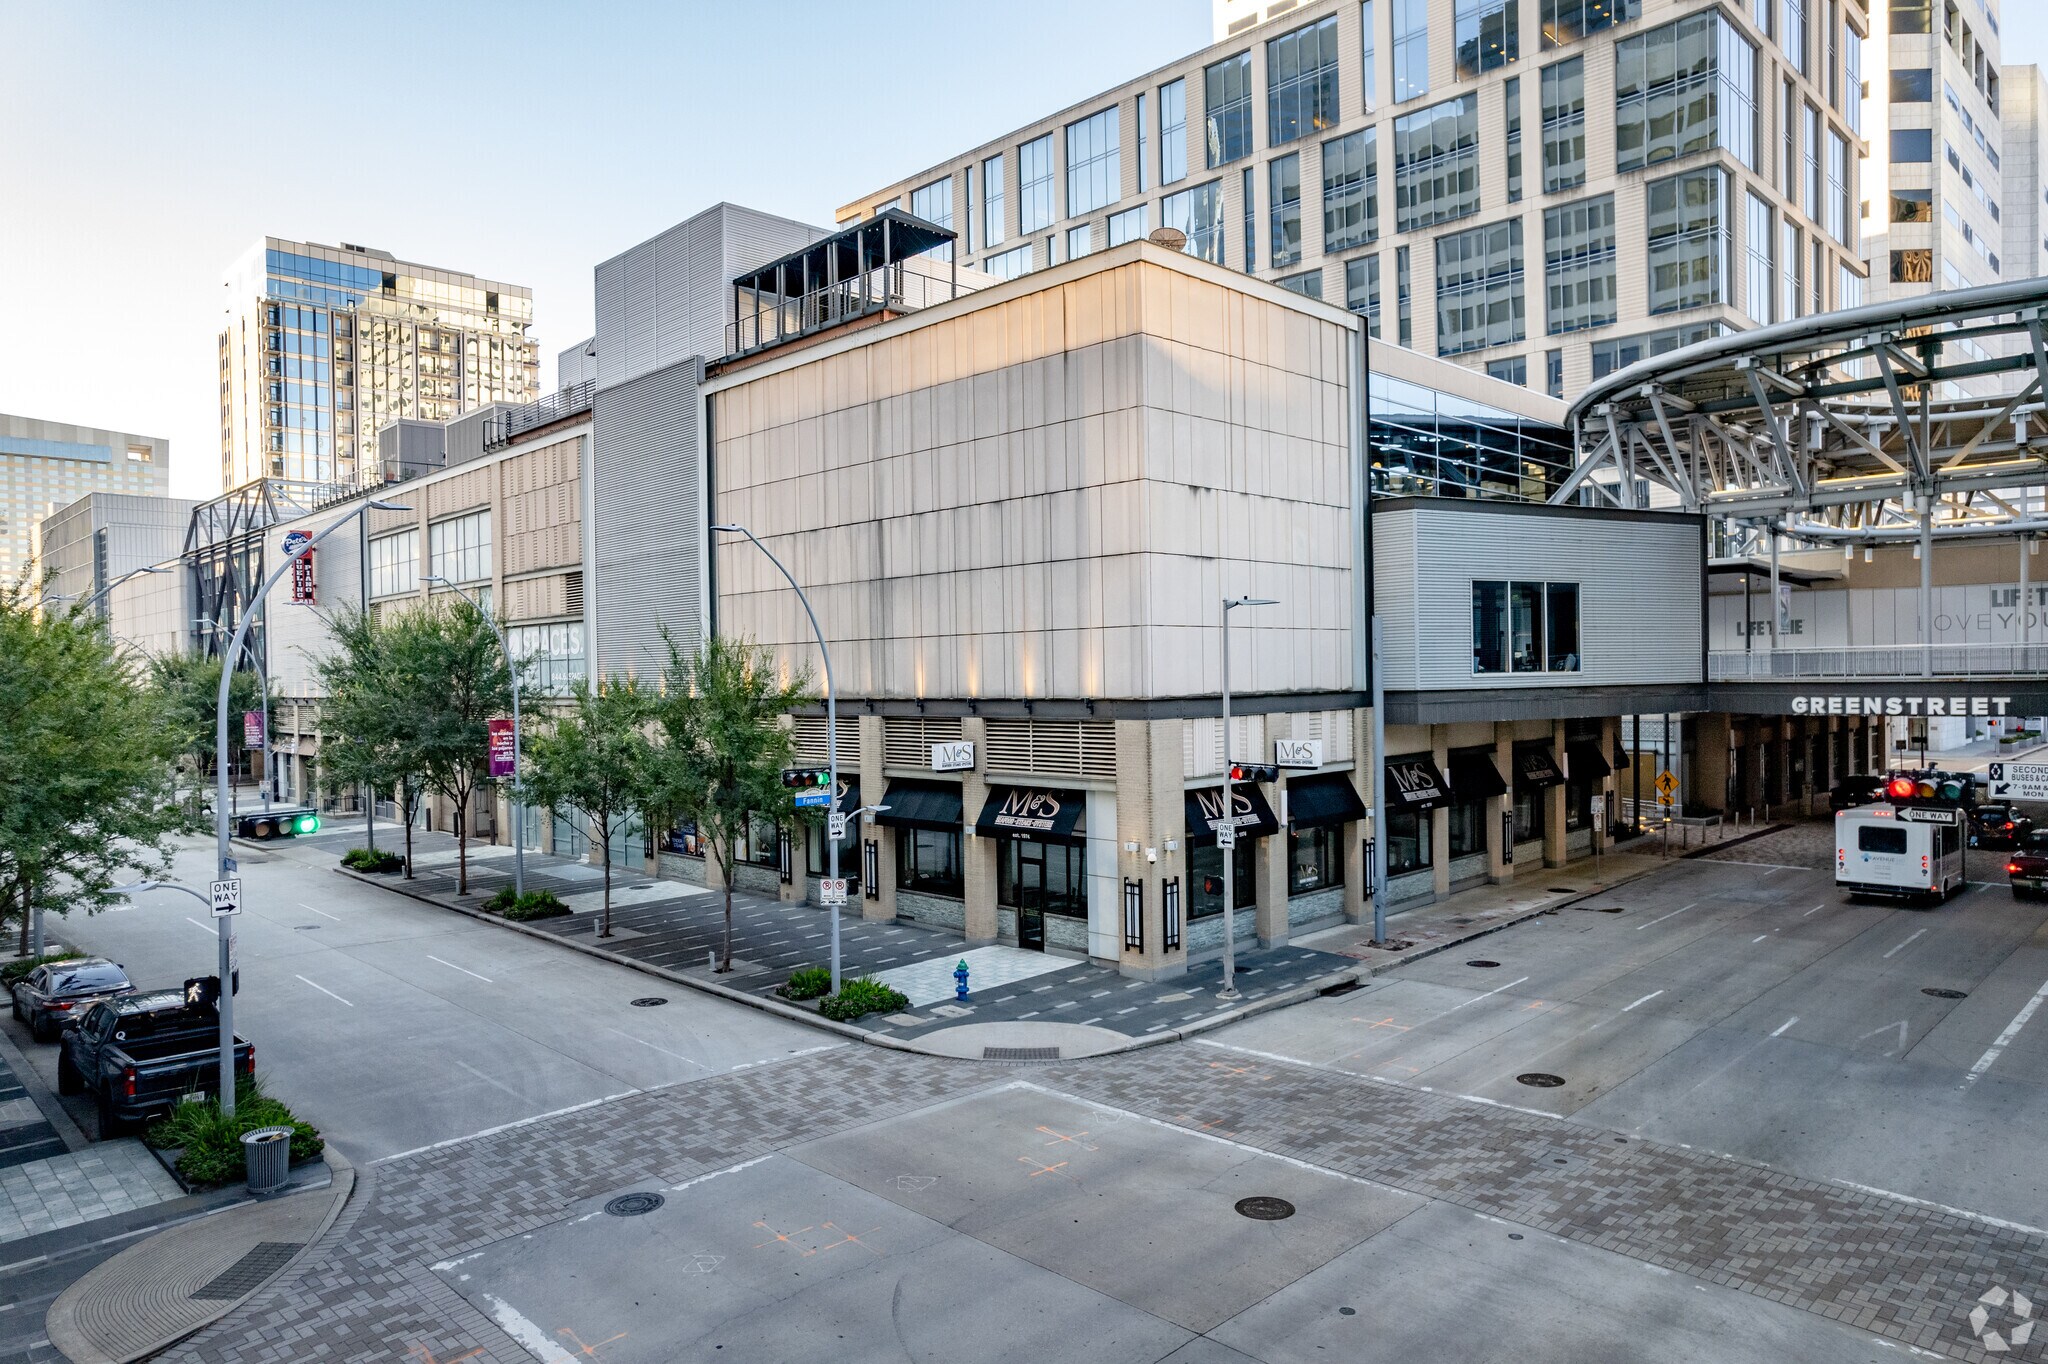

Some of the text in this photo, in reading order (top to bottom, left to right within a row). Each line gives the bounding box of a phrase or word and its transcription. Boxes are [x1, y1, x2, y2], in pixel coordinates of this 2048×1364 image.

[1736, 620, 1764, 636] LFE
[1791, 696, 2011, 715] GREENSTREET
[942, 744, 972, 762] M&S
[1280, 742, 1313, 759] M&S
[1388, 763, 1434, 791] M&S
[999, 788, 1060, 817] M&S
[1195, 789, 1252, 819] MS
[1909, 811, 1927, 819] ONE
[214, 882, 238, 892] ONE
[214, 892, 238, 902] WAY
